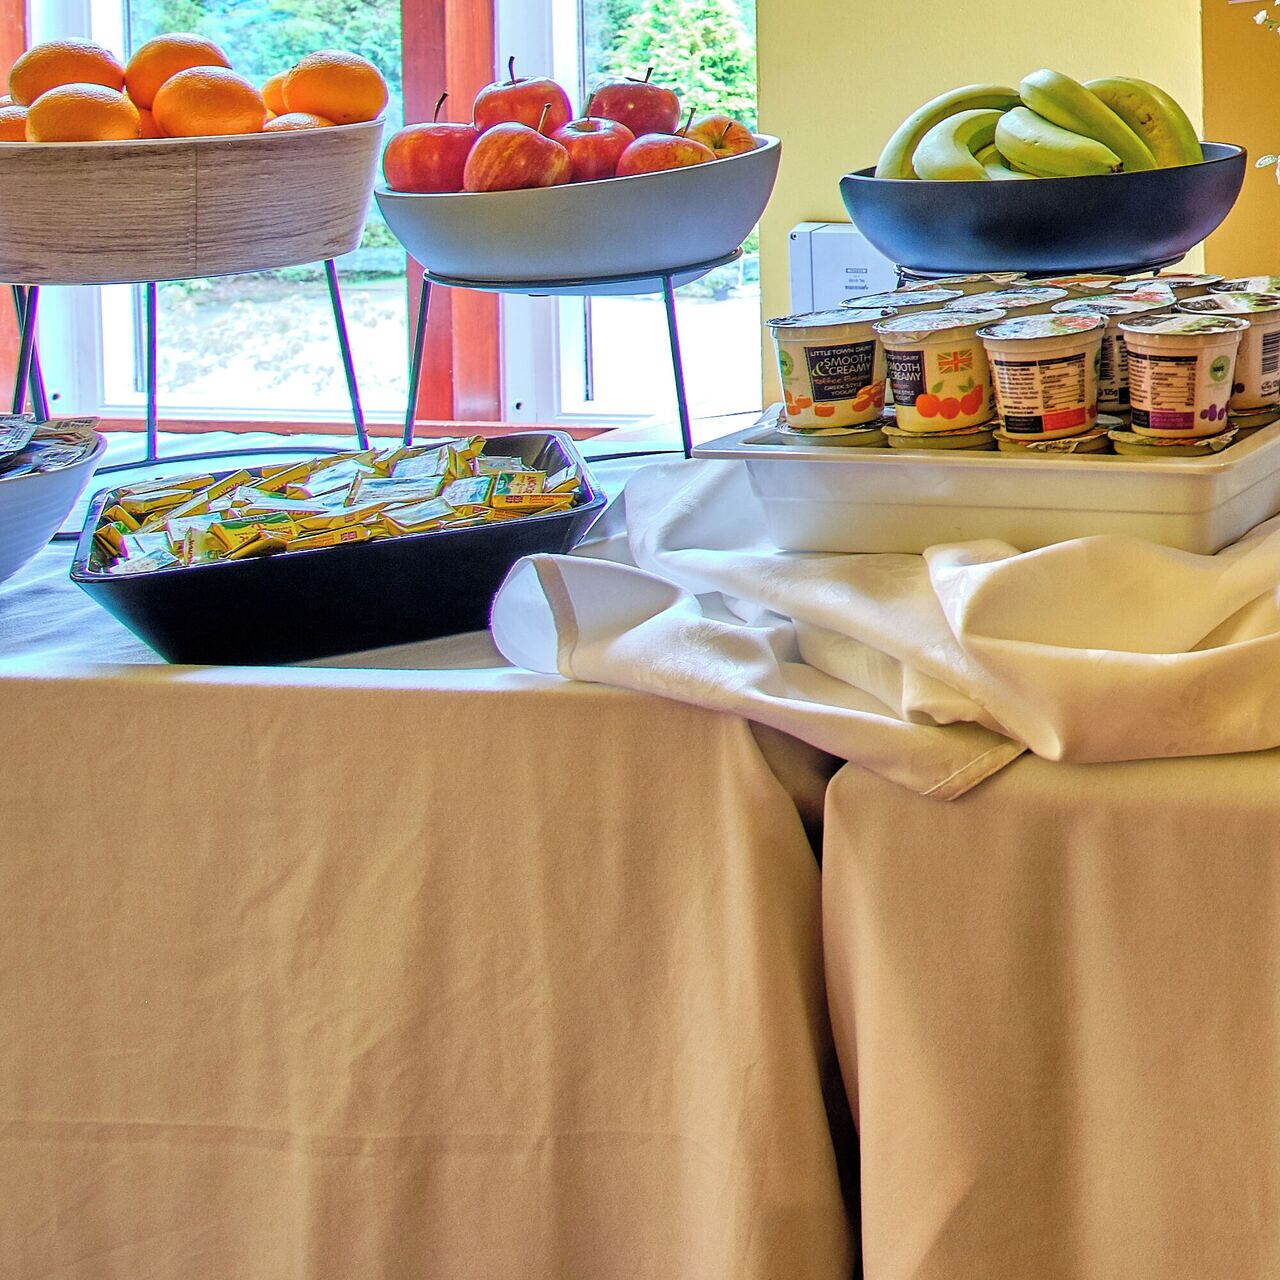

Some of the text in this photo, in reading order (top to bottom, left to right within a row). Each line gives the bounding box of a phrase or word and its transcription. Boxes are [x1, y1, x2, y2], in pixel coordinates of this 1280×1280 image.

[832, 347, 855, 355] TOWN
[824, 353, 872, 367] SMOOTH
[828, 362, 872, 376] CREAMY
